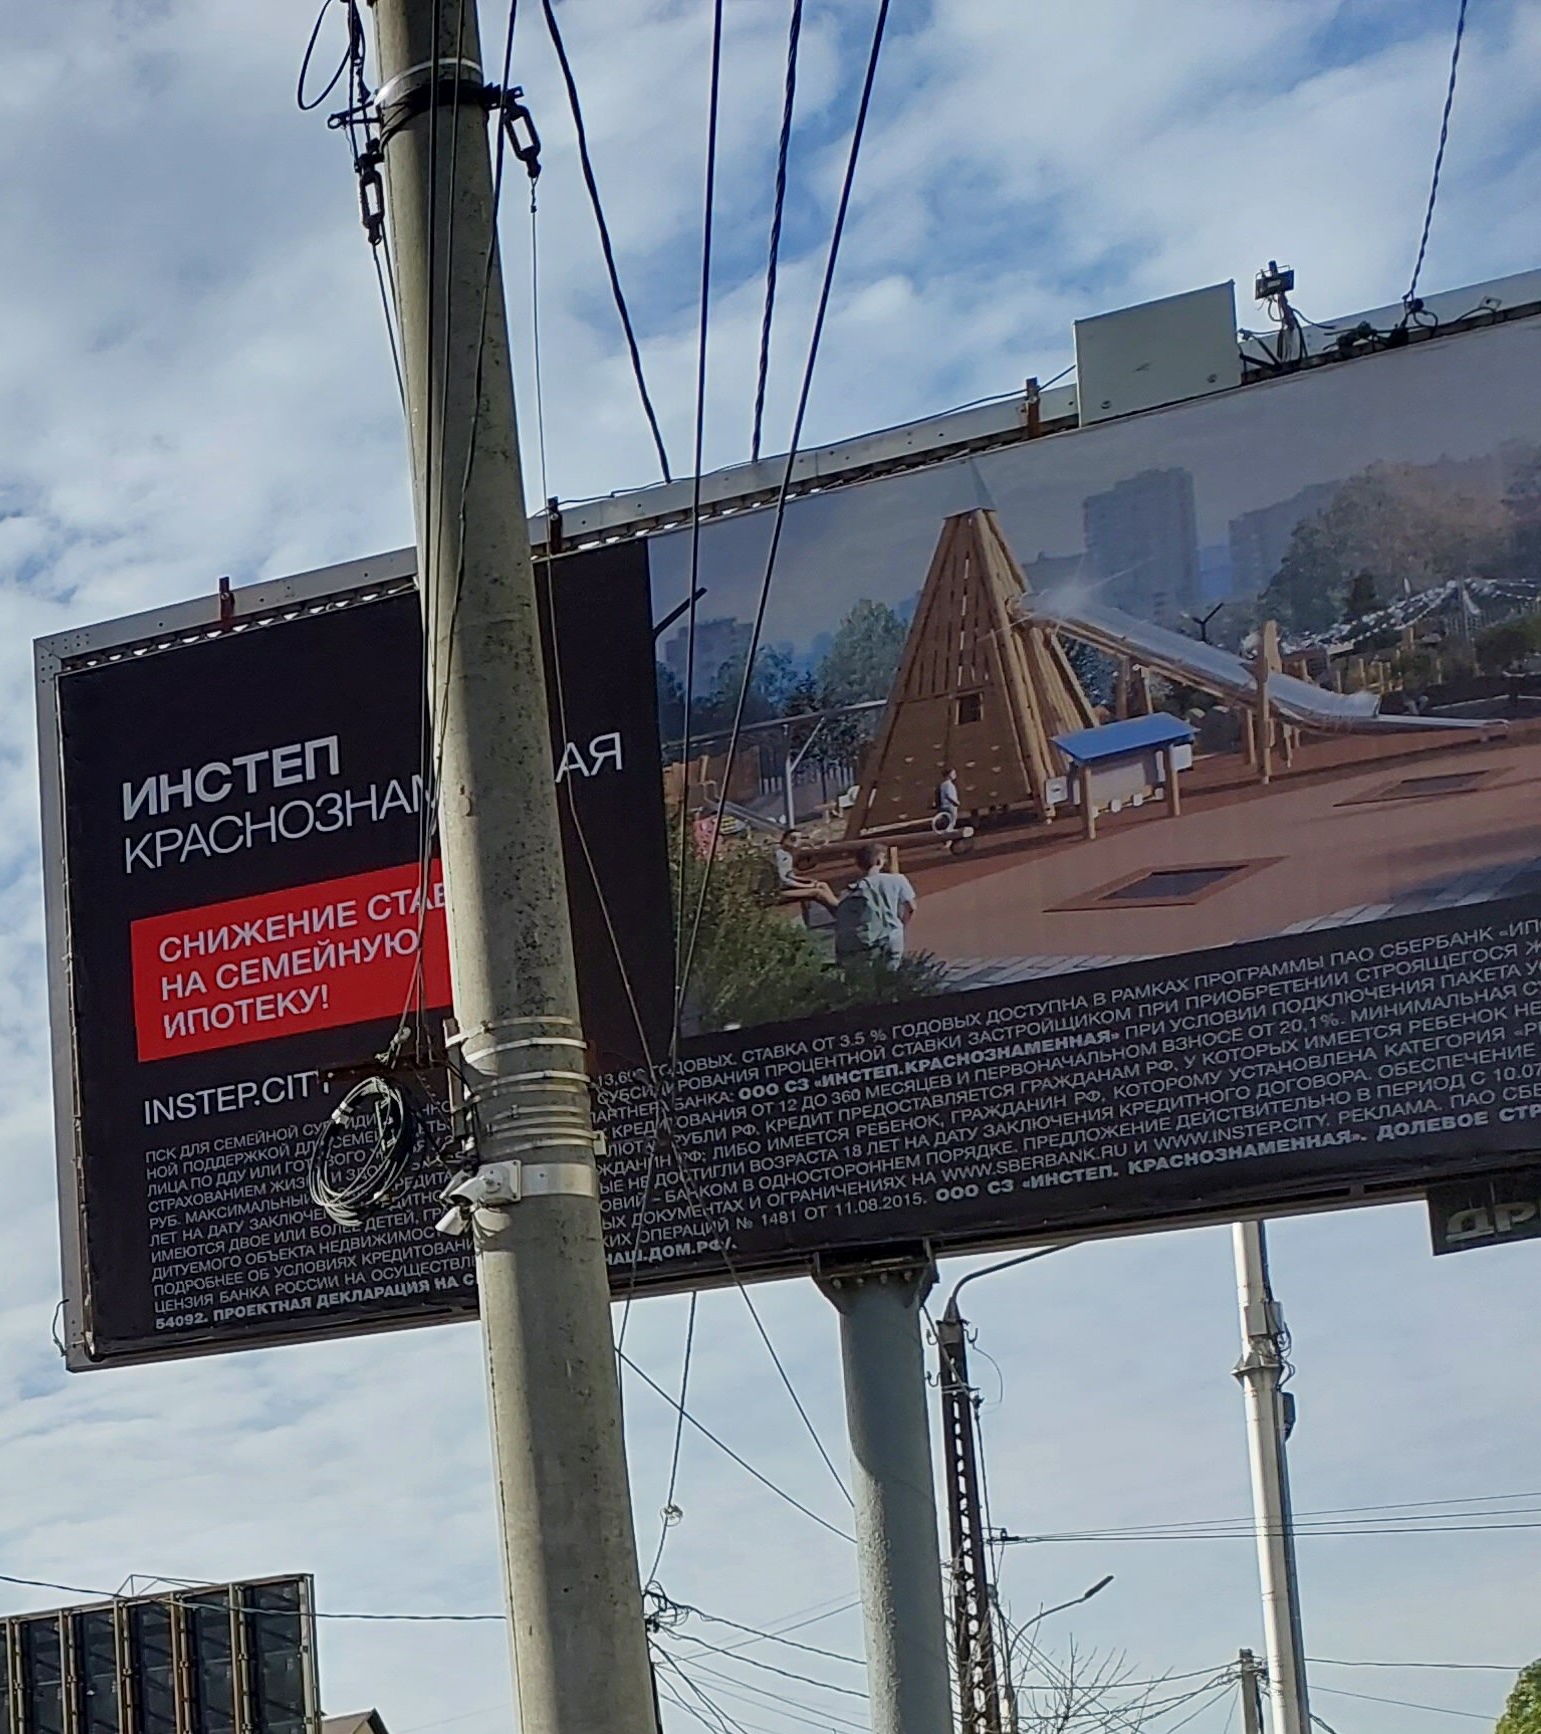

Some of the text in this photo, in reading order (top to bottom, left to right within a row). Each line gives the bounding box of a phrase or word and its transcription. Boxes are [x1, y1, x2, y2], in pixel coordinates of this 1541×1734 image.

[122, 735, 341, 821] ИНСТЕП
[158, 899, 358, 965] СНИЖЕНИЕ
[161, 924, 421, 1001] НА СЕМЕЙНУЮ
[163, 984, 330, 1040] ИПОТЕКУ!
[145, 1146, 176, 1163] ПСК
[179, 1141, 209, 1159] ДЛЯ
[213, 1125, 298, 1151] СЕМЕЙНОЙ
[742, 1040, 808, 1063] СТАВКА
[892, 1012, 981, 1040] ГОДОВЫХ
[985, 994, 1088, 1025] ДОСТУПНА
[1111, 977, 1188, 1002] РАМКАХ
[1195, 955, 1323, 988] ПРОГРАММЫ
[1330, 946, 1373, 966] ПАО
[1380, 926, 1492, 958] СБЕРБАНК
[146, 1163, 178, 1179] НОЙ
[183, 1144, 289, 1175] ПОДДЕРЖКОЙ
[765, 1046, 885, 1079] ПРОЦЕНТНОЙ
[891, 1034, 961, 1057] СТАВКИ
[968, 1007, 1130, 1047] ЗАСТРОЙЩИКОМ
[1138, 999, 1178, 1017] ПРИ
[1185, 971, 1347, 1010] ПРИОБРЕТЕНИИ
[1355, 943, 1517, 983] СТРОЯЩЕГОСЯ
[147, 1178, 188, 1198] ЛИЦА
[190, 1174, 212, 1189] ПО
[215, 1169, 246, 1187] ДДУ
[249, 1163, 281, 1180] ИЛИ
[738, 1082, 779, 1101] ООО
[1125, 1021, 1164, 1039] ПРИ
[1169, 1004, 1265, 1032] УСЛОВИИ
[1272, 977, 1434, 1017] ПОДКЛЮЧЕНИЯ
[1441, 963, 1521, 988] ПАКЕТА
[148, 1183, 266, 1213] СТРАХОВАНИЕМ
[801, 1093, 827, 1111] ДО
[831, 1088, 860, 1104] 360
[865, 1074, 952, 1101] МЕСЯЦЕВ
[974, 1041, 1156, 1082] ПЕРВОНАЧАЛЬНОМ
[1162, 1028, 1243, 1053] ВЗНОСЕ
[1351, 984, 1516, 1023] МИНИМАЛЬНАЯ
[149, 1231, 177, 1247] ЛЕТ
[182, 1227, 203, 1241] НА
[207, 1220, 244, 1239] ДАТУ
[712, 1140, 761, 1160] ЛИБО
[767, 1127, 848, 1151] ИМЕЕТСЯ
[856, 1113, 943, 1139] РЕБЕНОК,
[951, 1094, 1066, 1125] ГРАЖДАНИН
[1114, 1070, 1221, 1099] КОТОРОМУ
[1229, 1046, 1377, 1081] УСТАНОВЛЕНА
[1385, 1027, 1504, 1057] КАТЕГОРИЯ
[765, 1111, 831, 1135] КРЕДИТ
[837, 1083, 1014, 1124] ПРЕДОСТАВЛЯЕТСЯ
[1021, 1064, 1139, 1096] ГРАЖДАНАМ
[1202, 1039, 1298, 1066] КОТОРЫХ
[1305, 1023, 1401, 1050] ИМЕЕТСЯ
[1408, 1006, 1507, 1034] РЕБЕНОК
[151, 1240, 224, 1263] ИМЕЮТСЯ
[228, 1233, 270, 1253] ДВОЕ
[274, 1228, 305, 1244] ИЛИ
[750, 1147, 838, 1172] ВОЗРАСТА
[866, 1138, 900, 1155] ЛЕТ
[904, 1134, 929, 1149] НА
[933, 1127, 978, 1147] ДАТУ
[983, 1106, 1113, 1138] ЗАКЛЮЧЕНИЯ
[1120, 1085, 1250, 1119] КРЕДИТНОГО
[1256, 1067, 1371, 1098] ДОГОВОРА.
[1378, 1042, 1535, 1078] ОБЕСПЕЧЕНИЕ
[151, 1255, 241, 1282] ДИТУЕМОГО
[245, 1244, 315, 1265] ОБЪЕКТА
[665, 1181, 737, 1203] БАНКОМ
[758, 1154, 920, 1191] ОДНОСТОРОННЕМ
[926, 1140, 1017, 1166] ПОРЯДКЕ.
[1023, 1117, 1171, 1152] ПРЕДЛОЖЕНИЕ
[1176, 1090, 1350, 1130] ДЕЙСТВИТЕЛЬНО
[1377, 1073, 1465, 1100] ПЕРИОД
[154, 1271, 243, 1298] ПОДРОБНЕЕ
[247, 1267, 269, 1282] ОБ
[274, 1255, 356, 1278] УСЛОВИЯХ
[766, 1175, 906, 1206] ОГРАНИЧЕНИЯХ
[912, 1170, 936, 1186] НА
[941, 1143, 1126, 1182] WWW.SBERBANK.RU
[1338, 1097, 1441, 1124] РЕКЛАМА.
[1450, 1089, 1494, 1108] ПАО
[155, 1293, 213, 1315] ЦЕНЗИЯ
[219, 1284, 269, 1303] БАНКА
[275, 1274, 339, 1295] РОССИИ
[344, 1271, 366, 1285] НА
[761, 1209, 795, 1225] 1481
[835, 1190, 926, 1215] 11.08.2015.
[936, 1183, 978, 1201] ООО
[1376, 1110, 1488, 1140] ДОЛЕВОЕ
[155, 1310, 208, 1330] 54092.
[213, 1295, 311, 1321] ПРОЕКТНАЯ
[315, 1278, 429, 1308] ДЕКЛАРАЦИЯ
[434, 1274, 459, 1289] НА
